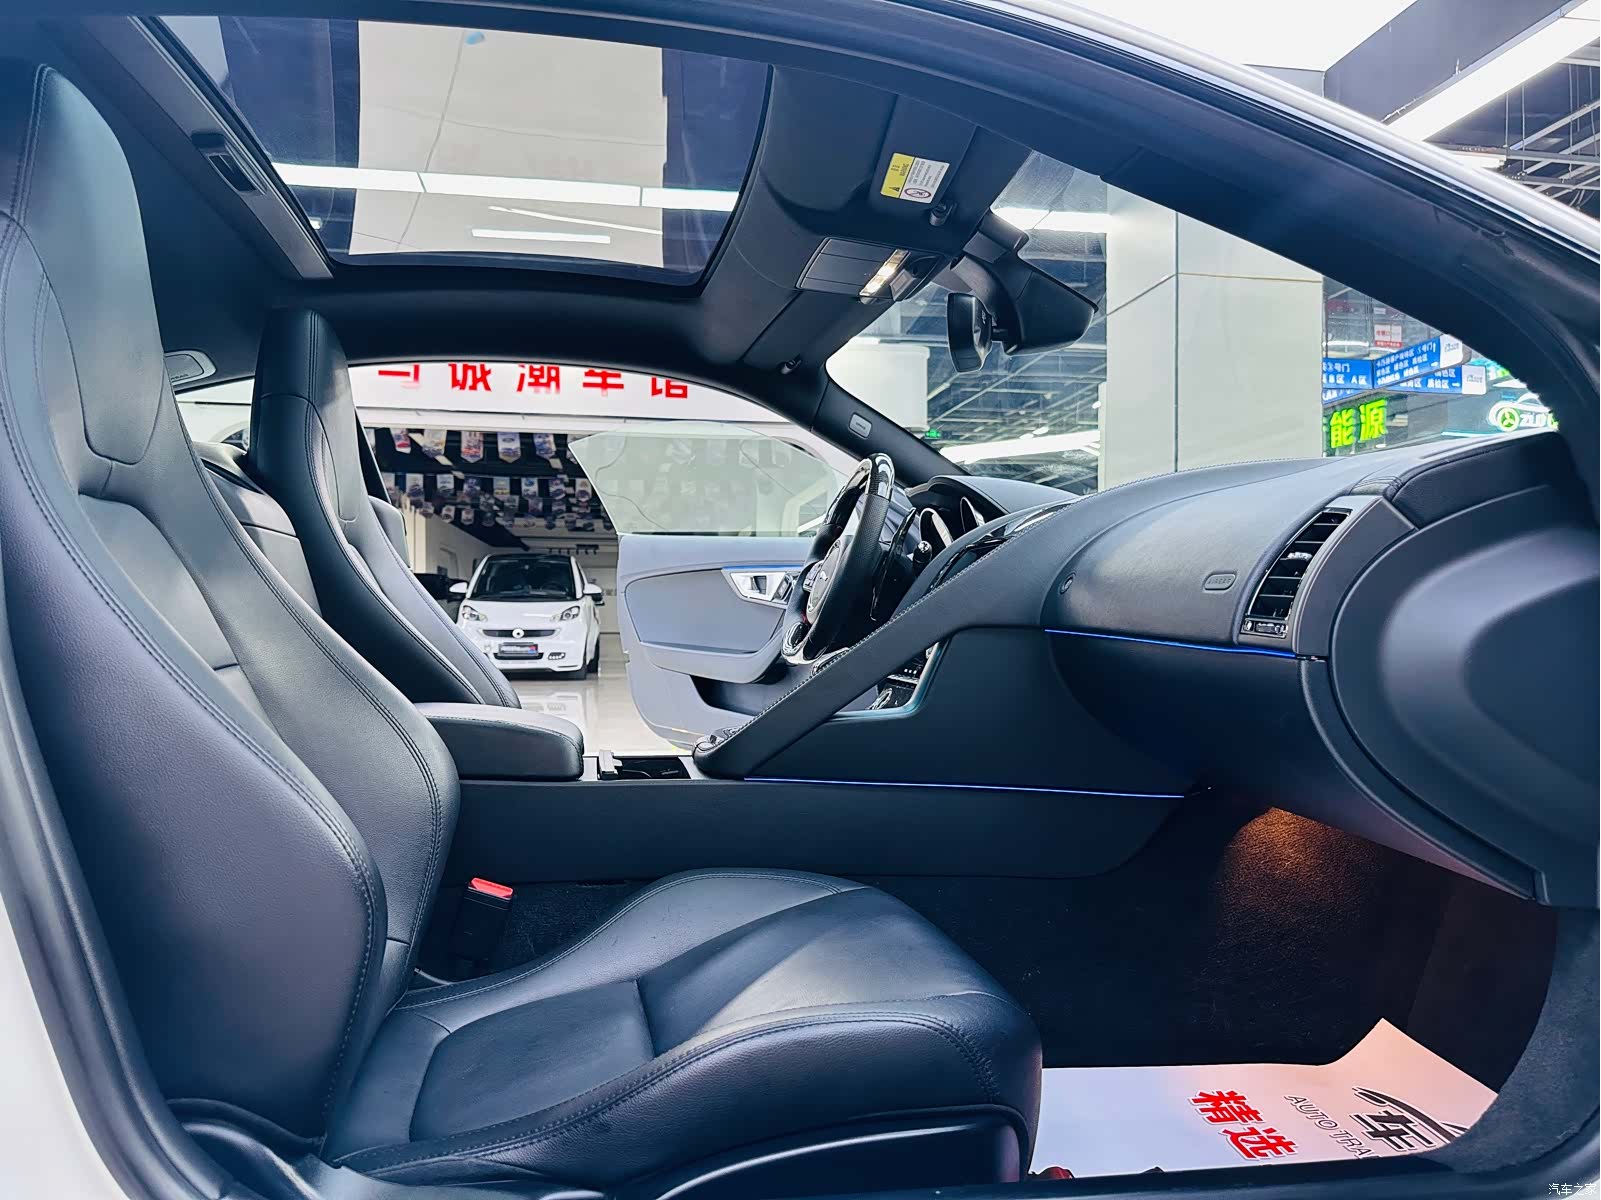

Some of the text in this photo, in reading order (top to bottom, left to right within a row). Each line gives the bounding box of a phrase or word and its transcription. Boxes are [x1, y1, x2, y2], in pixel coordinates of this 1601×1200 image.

[1323, 399, 1388, 448] 能源
[1191, 1090, 1297, 1159] 精选
[1284, 1094, 1377, 1158] AUTO TRA
